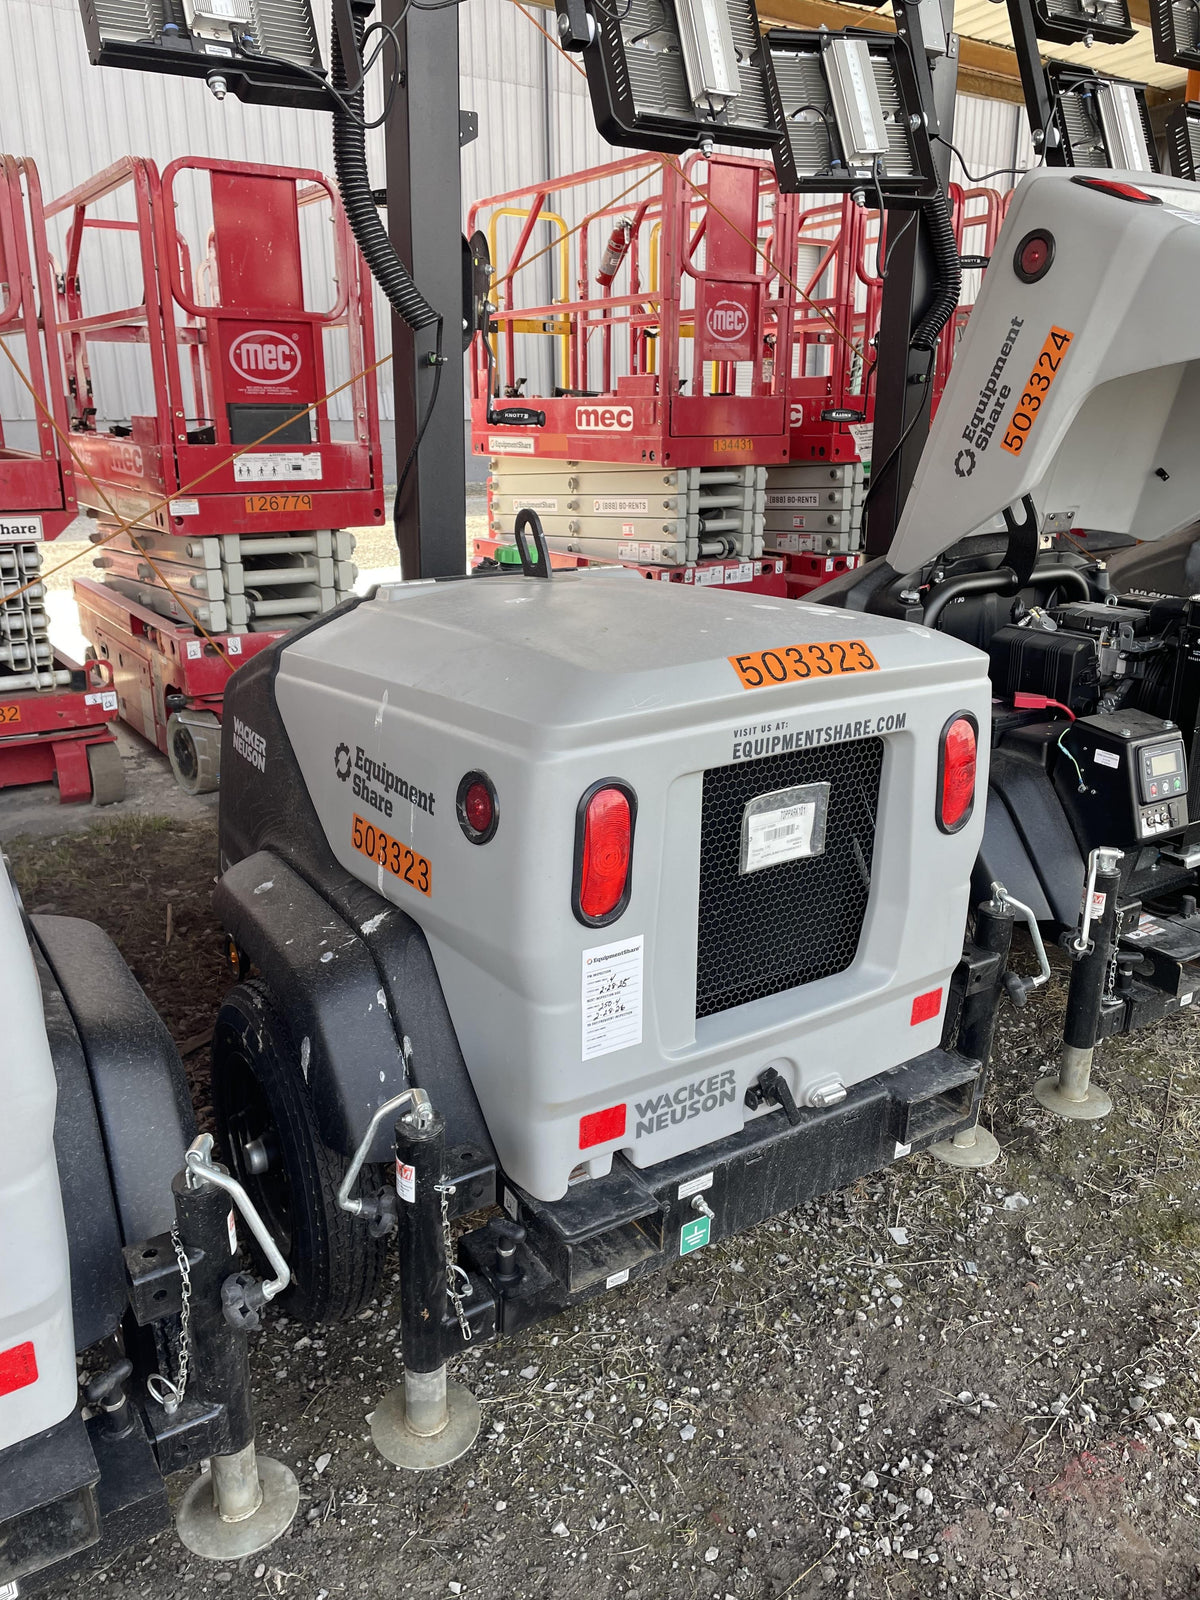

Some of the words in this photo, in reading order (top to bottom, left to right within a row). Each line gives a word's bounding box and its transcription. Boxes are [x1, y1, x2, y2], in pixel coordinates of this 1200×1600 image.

[713, 310, 743, 331] mec
[240, 343, 291, 370] mec
[961, 315, 1024, 444] Equipment
[1003, 330, 1071, 451] 503324
[577, 408, 632, 428] mec
[975, 384, 1011, 451] Share
[715, 439, 752, 450] 134431
[247, 494, 312, 511] 126779
[736, 642, 874, 686] 503323
[233, 715, 267, 756] WACKER
[732, 712, 907, 760] EQUIPMENTSHARE.COM
[733, 726, 757, 738] VISIT
[761, 724, 772, 733] US
[775, 721, 789, 730] AT:
[233, 732, 265, 773] NEUSON
[352, 774, 393, 818] Share
[354, 745, 435, 816] Equipment
[353, 816, 429, 893] 503323
[634, 1069, 736, 1119] WACKER
[635, 1085, 736, 1139] NEUSON
